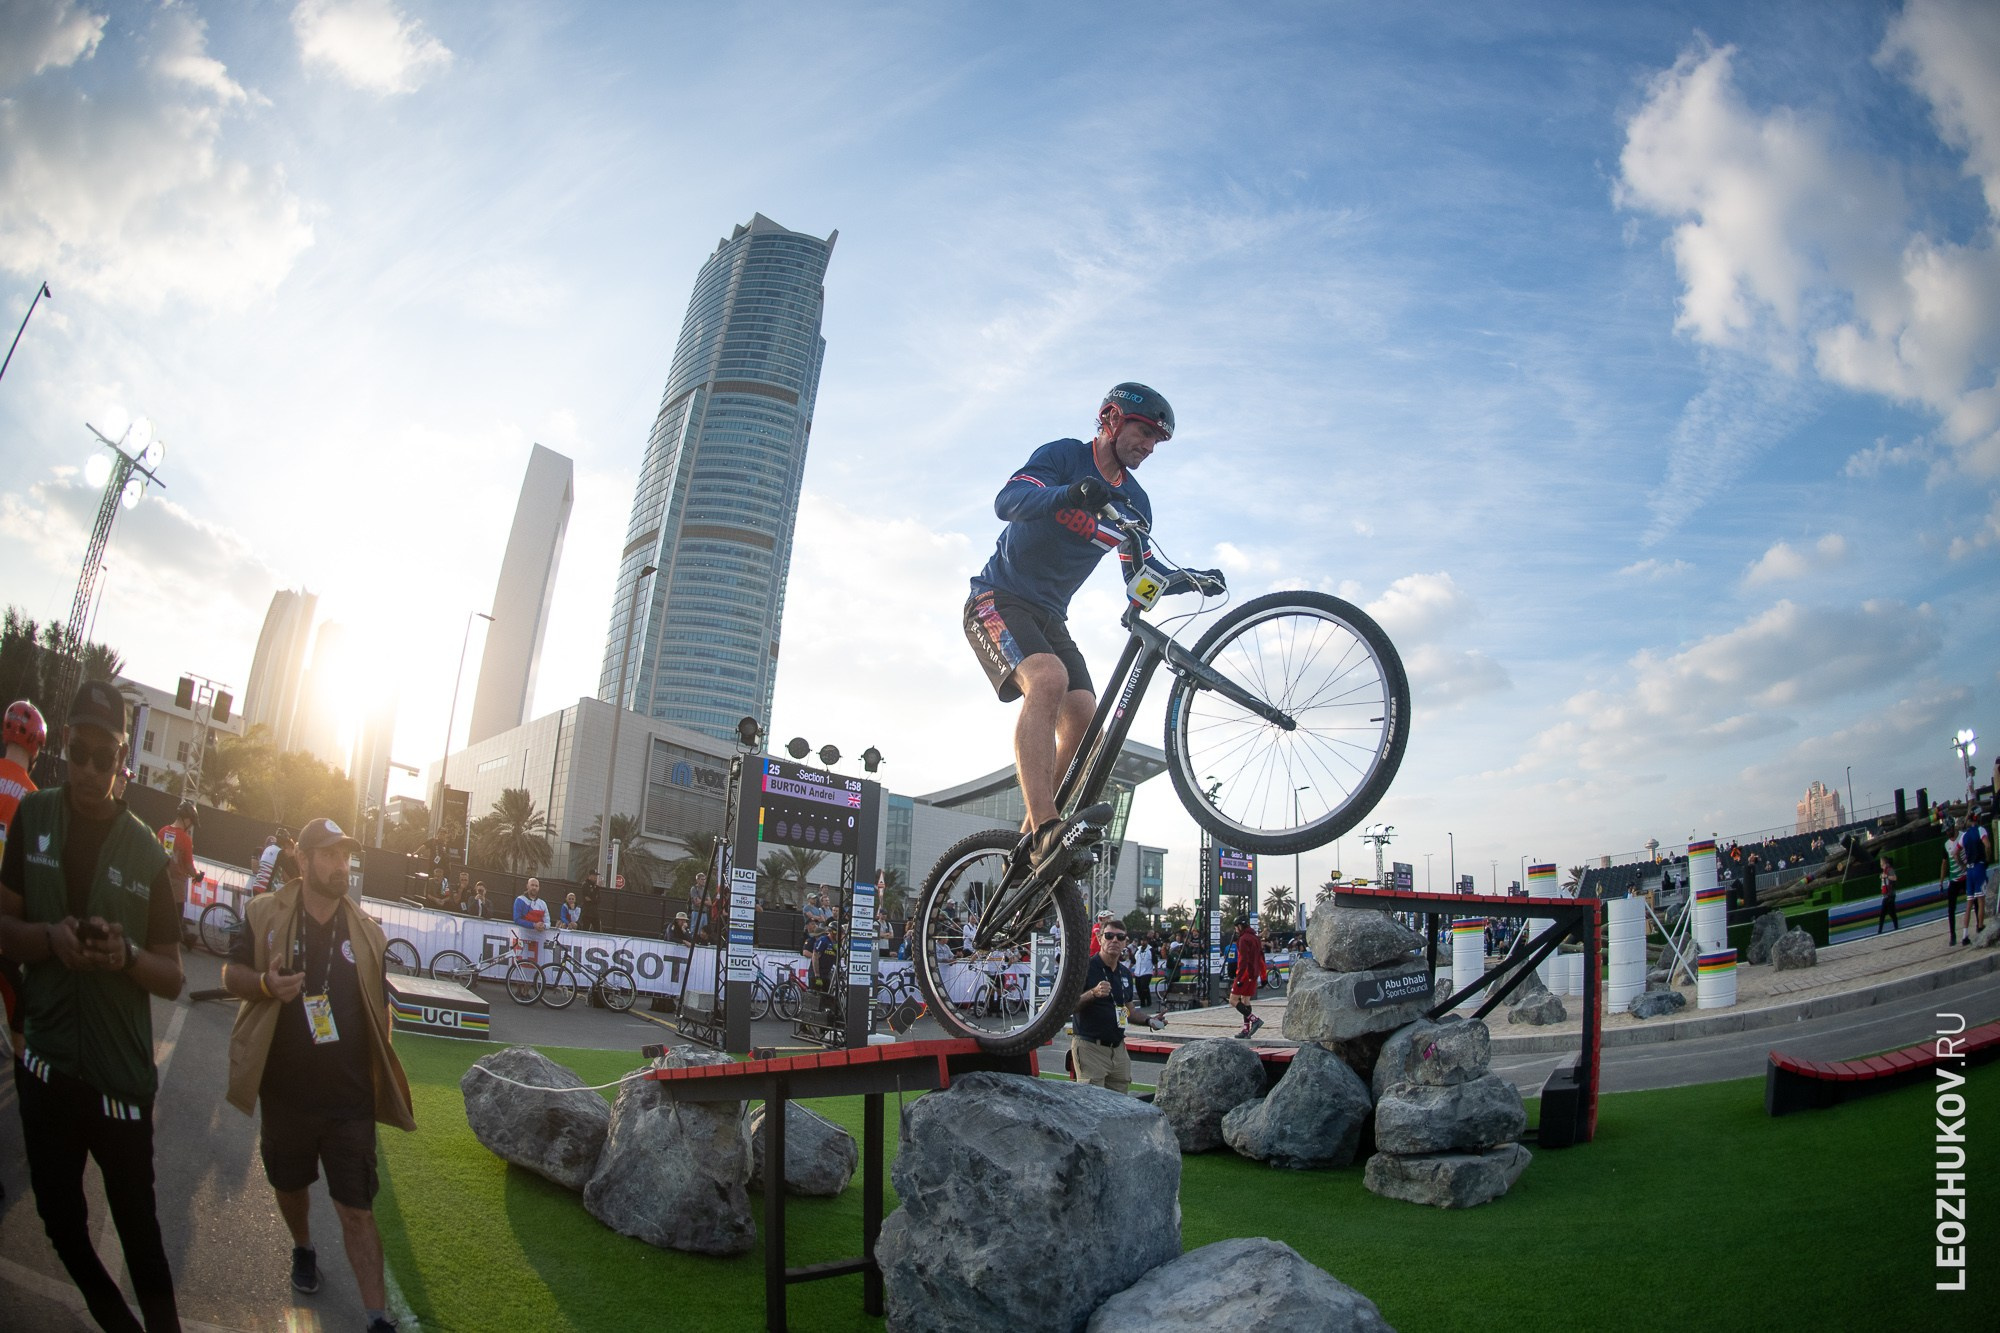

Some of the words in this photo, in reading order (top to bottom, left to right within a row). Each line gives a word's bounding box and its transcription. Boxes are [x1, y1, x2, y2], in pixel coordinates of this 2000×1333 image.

[1055, 508, 1095, 540] GBR
[1119, 666, 1142, 709] SALTROCK
[694, 766, 727, 790] VOX
[768, 763, 780, 775] 25
[844, 779, 862, 791] 1:58
[770, 779, 807, 795] BURTON
[808, 787, 836, 800] Andrei
[847, 816, 855, 828] 0
[739, 871, 755, 880] UCI
[1037, 948, 1054, 956] START
[543, 942, 689, 983] TISSOT
[734, 959, 750, 967] UCI
[855, 964, 869, 972] UCI
[1041, 956, 1050, 974] 2
[1385, 979, 1401, 989] Abu
[1402, 973, 1426, 984] Dhabi
[1386, 988, 1406, 998] Sports
[1406, 983, 1428, 994] Council
[423, 1007, 459, 1027] UCI
